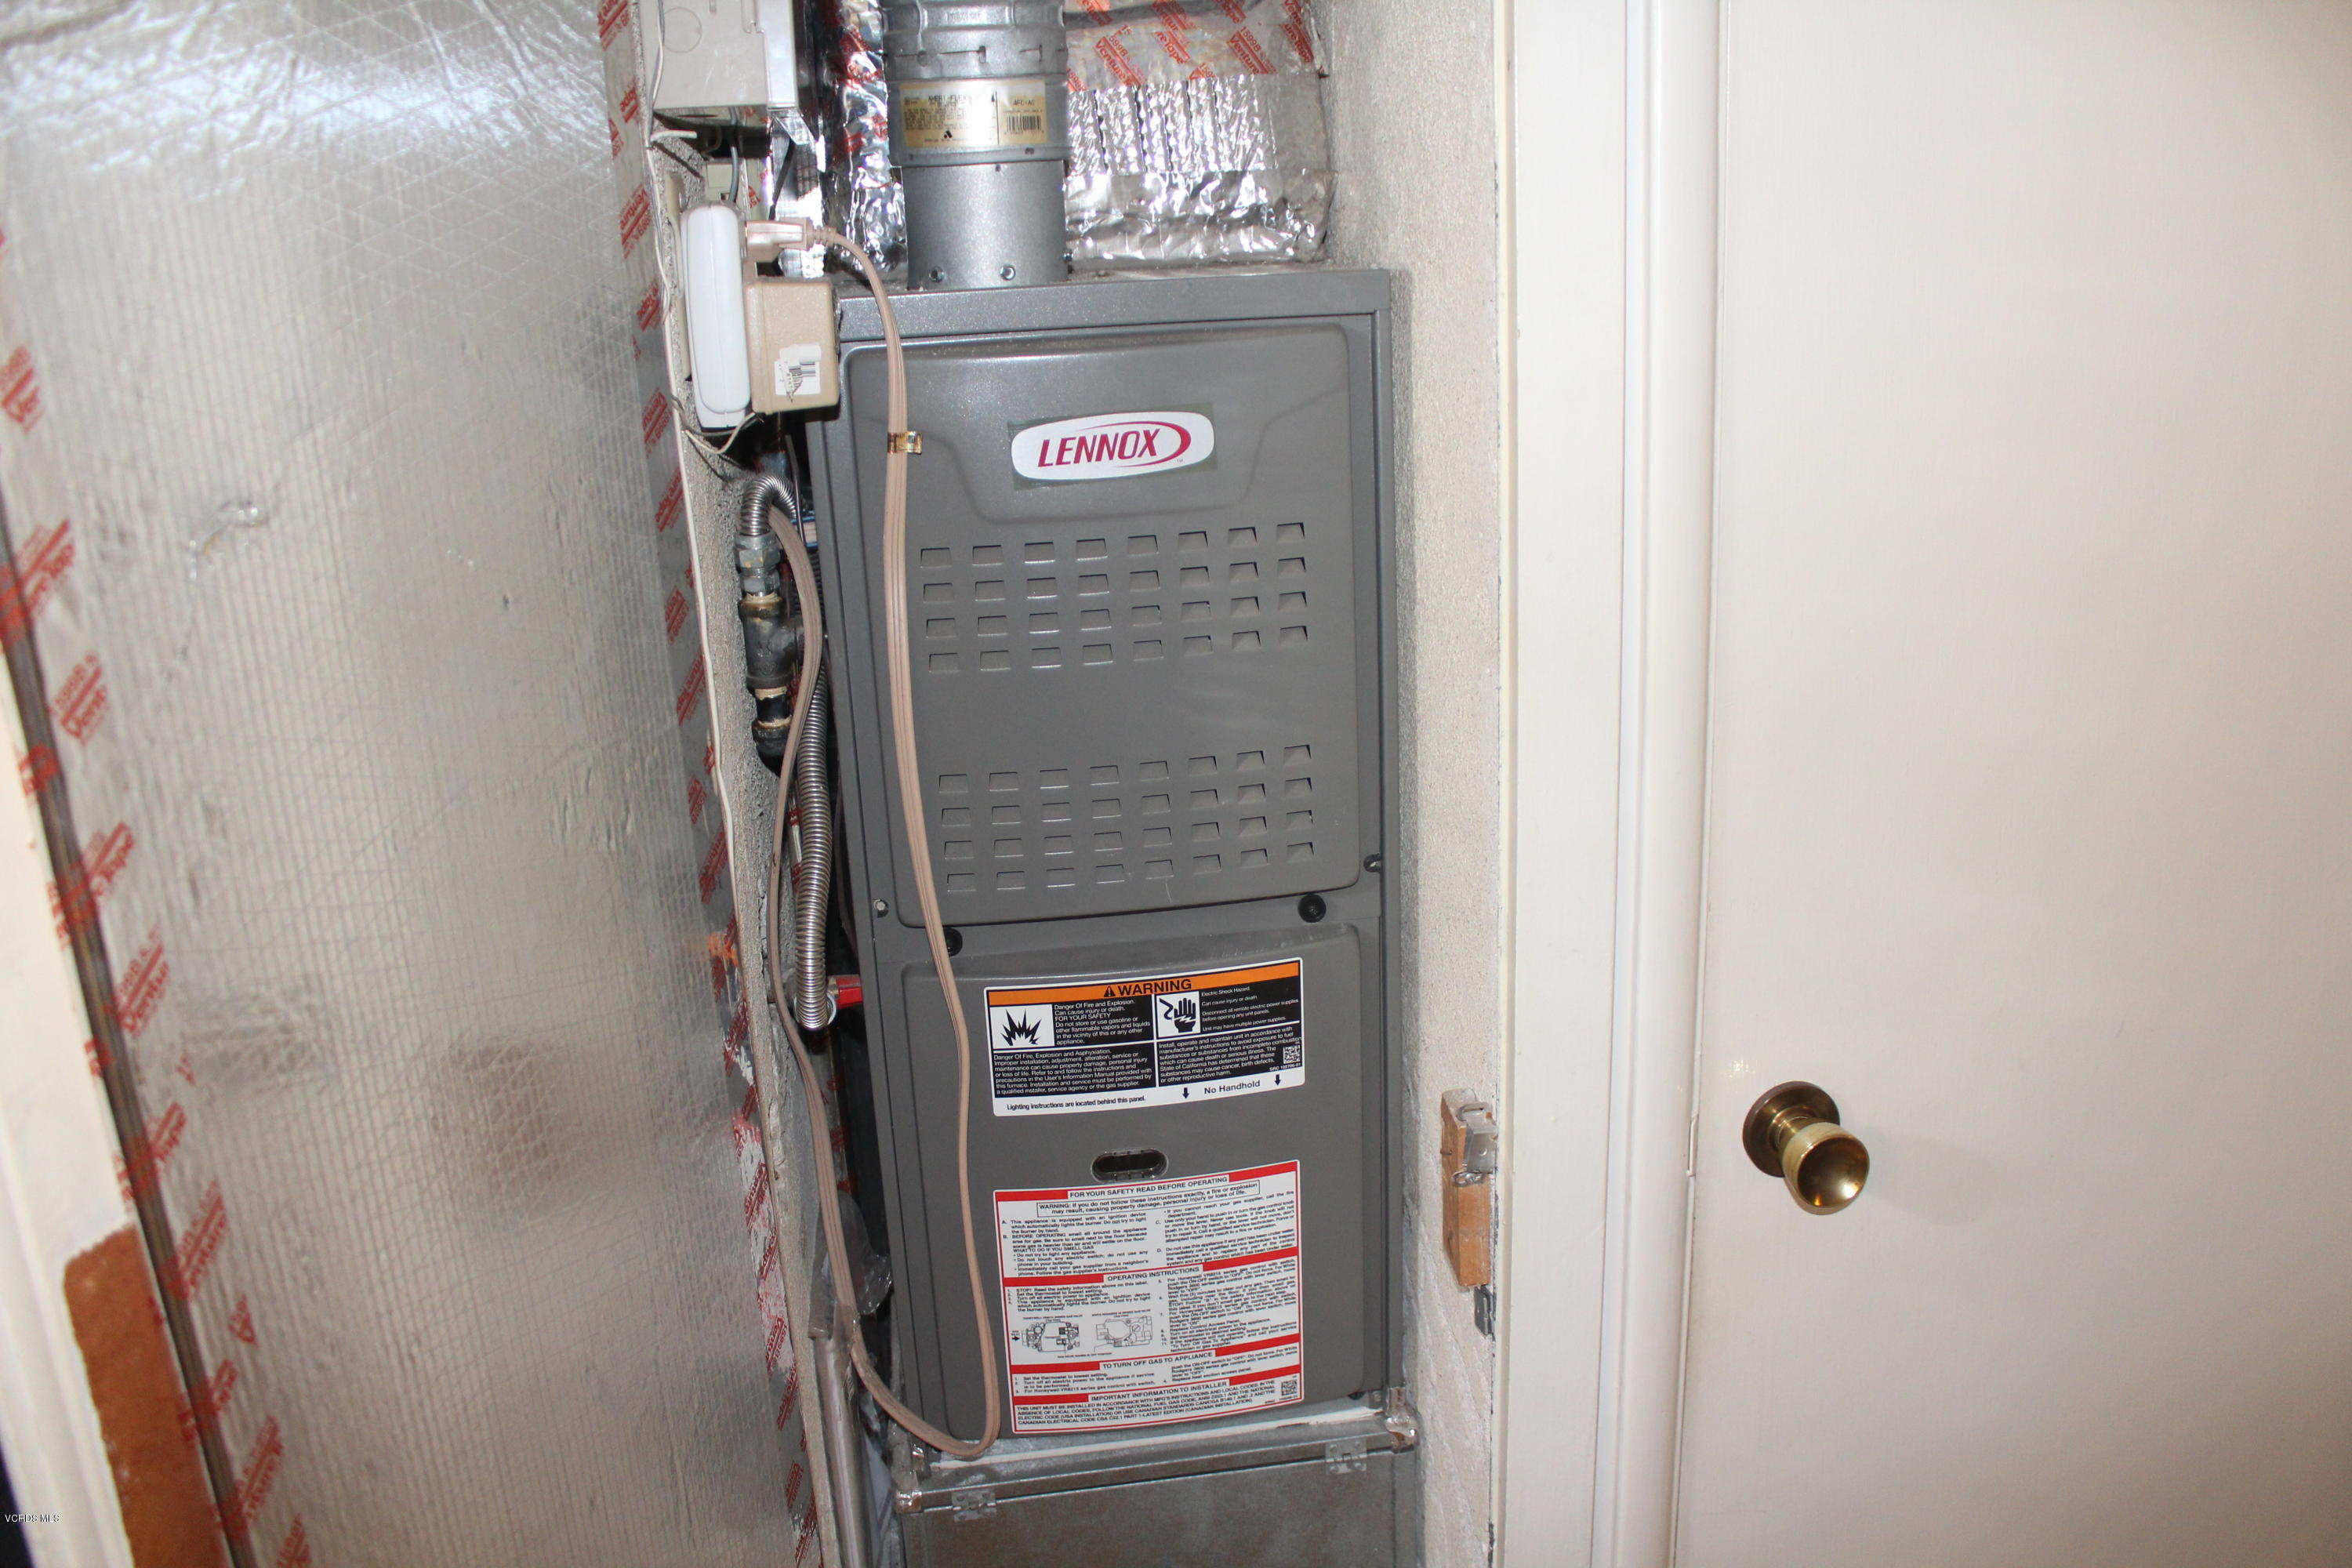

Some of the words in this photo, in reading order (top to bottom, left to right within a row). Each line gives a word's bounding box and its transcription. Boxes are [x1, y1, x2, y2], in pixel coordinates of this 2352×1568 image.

[1240, 26, 1261, 52] 1599B
[1095, 39, 1126, 79] Venture
[1229, 36, 1260, 74] Venture
[1037, 428, 1160, 468] LENNOX
[1117, 978, 1192, 996] WARNING
[1106, 998, 1134, 1007] Explosion.
[1177, 1039, 1197, 1047] operate
[1250, 1027, 1280, 1036] accordance
[1075, 1048, 1111, 1057] Asphyxiation.
[1159, 1044, 1198, 1054] manufacturer's
[1200, 1040, 1229, 1049] instructions
[1218, 1080, 1260, 1092] Handhold
[1129, 1094, 1145, 1103] panel.
[1157, 1181, 1185, 1190] BEFORE
[1187, 1176, 1227, 1187] OPERATING
[1147, 1192, 1182, 1202] instructions
[1183, 1190, 1205, 1199] exactly,
[1229, 1182, 1258, 1193] explosion
[1110, 1203, 1135, 1211] property
[1136, 1200, 1162, 1209] damage,
[1163, 1197, 1188, 1206] personal
[1107, 1272, 1147, 1281] OPERATING
[1149, 1266, 1199, 1277] INSTRUCTIONS
[1174, 1351, 1212, 1362] APPLIANCE
[1091, 1392, 1131, 1401] IMPORTANT
[1131, 1388, 1178, 1397] INFORMATION
[1190, 1381, 1226, 1391] INSTALLER
